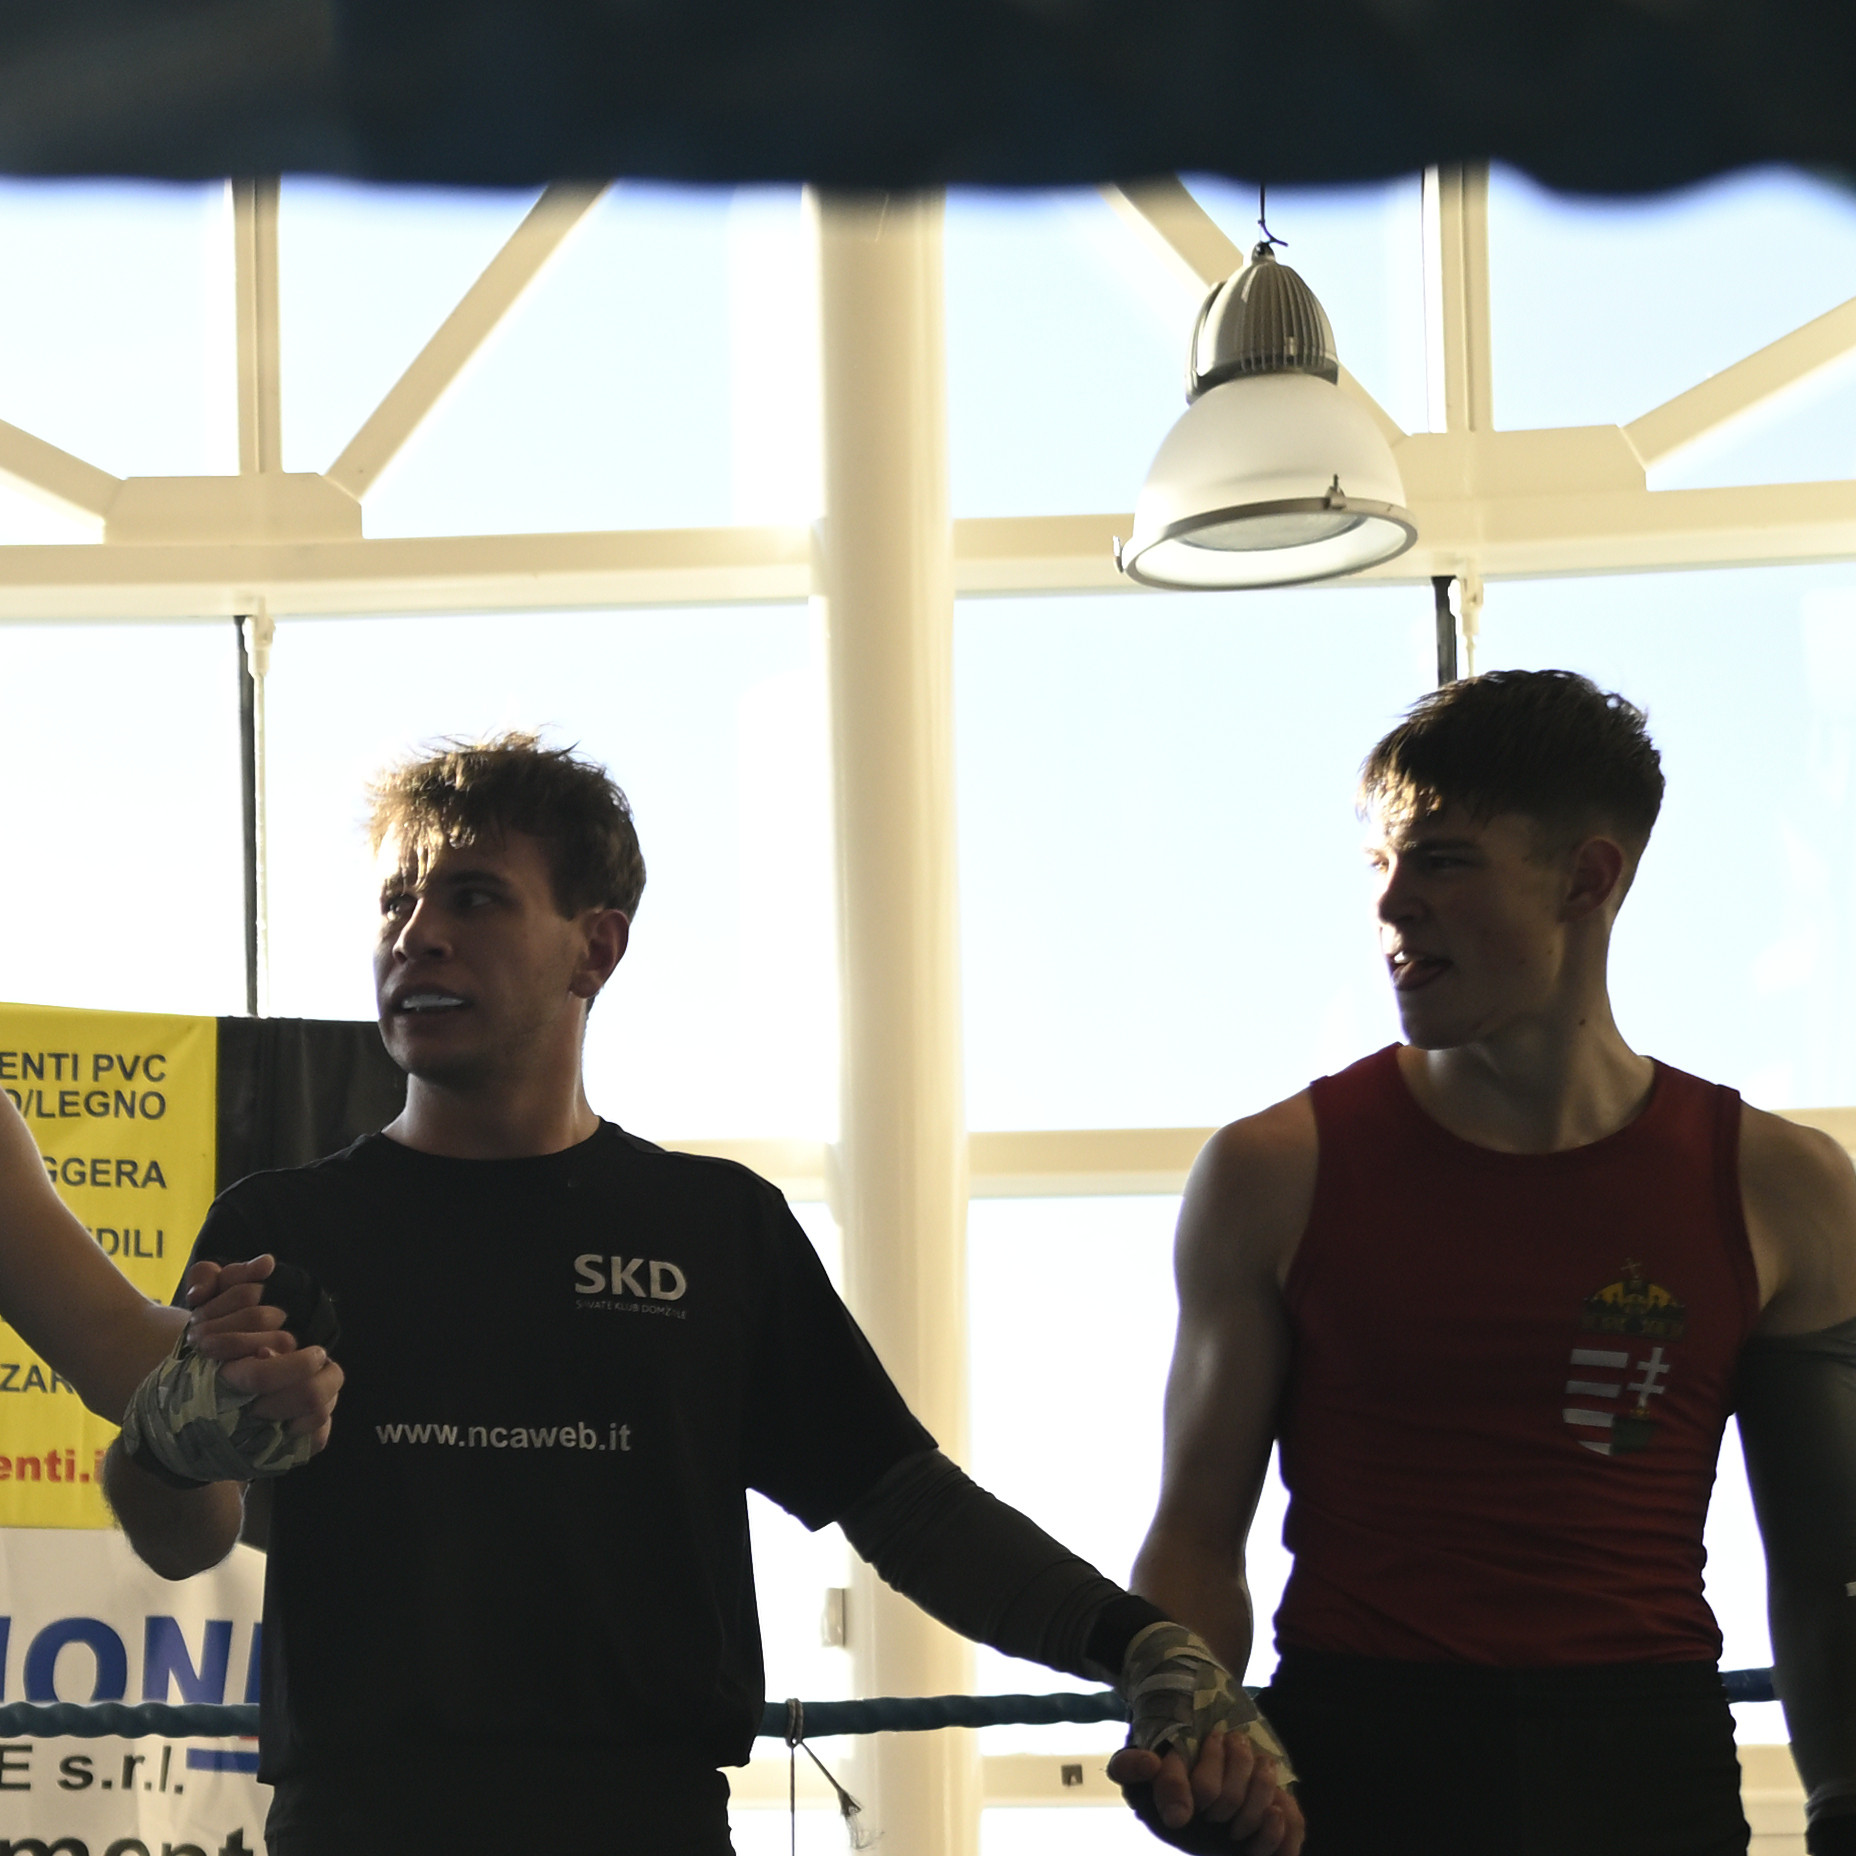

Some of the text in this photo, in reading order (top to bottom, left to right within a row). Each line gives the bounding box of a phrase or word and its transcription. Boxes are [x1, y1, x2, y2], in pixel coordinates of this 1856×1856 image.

[92, 1053, 167, 1083] PVC
[86, 1227, 164, 1259] DILI
[573, 1253, 687, 1302] SKD
[374, 1421, 632, 1452] www.ncaweb.it
[56, 1744, 186, 1796] s.r.l.
